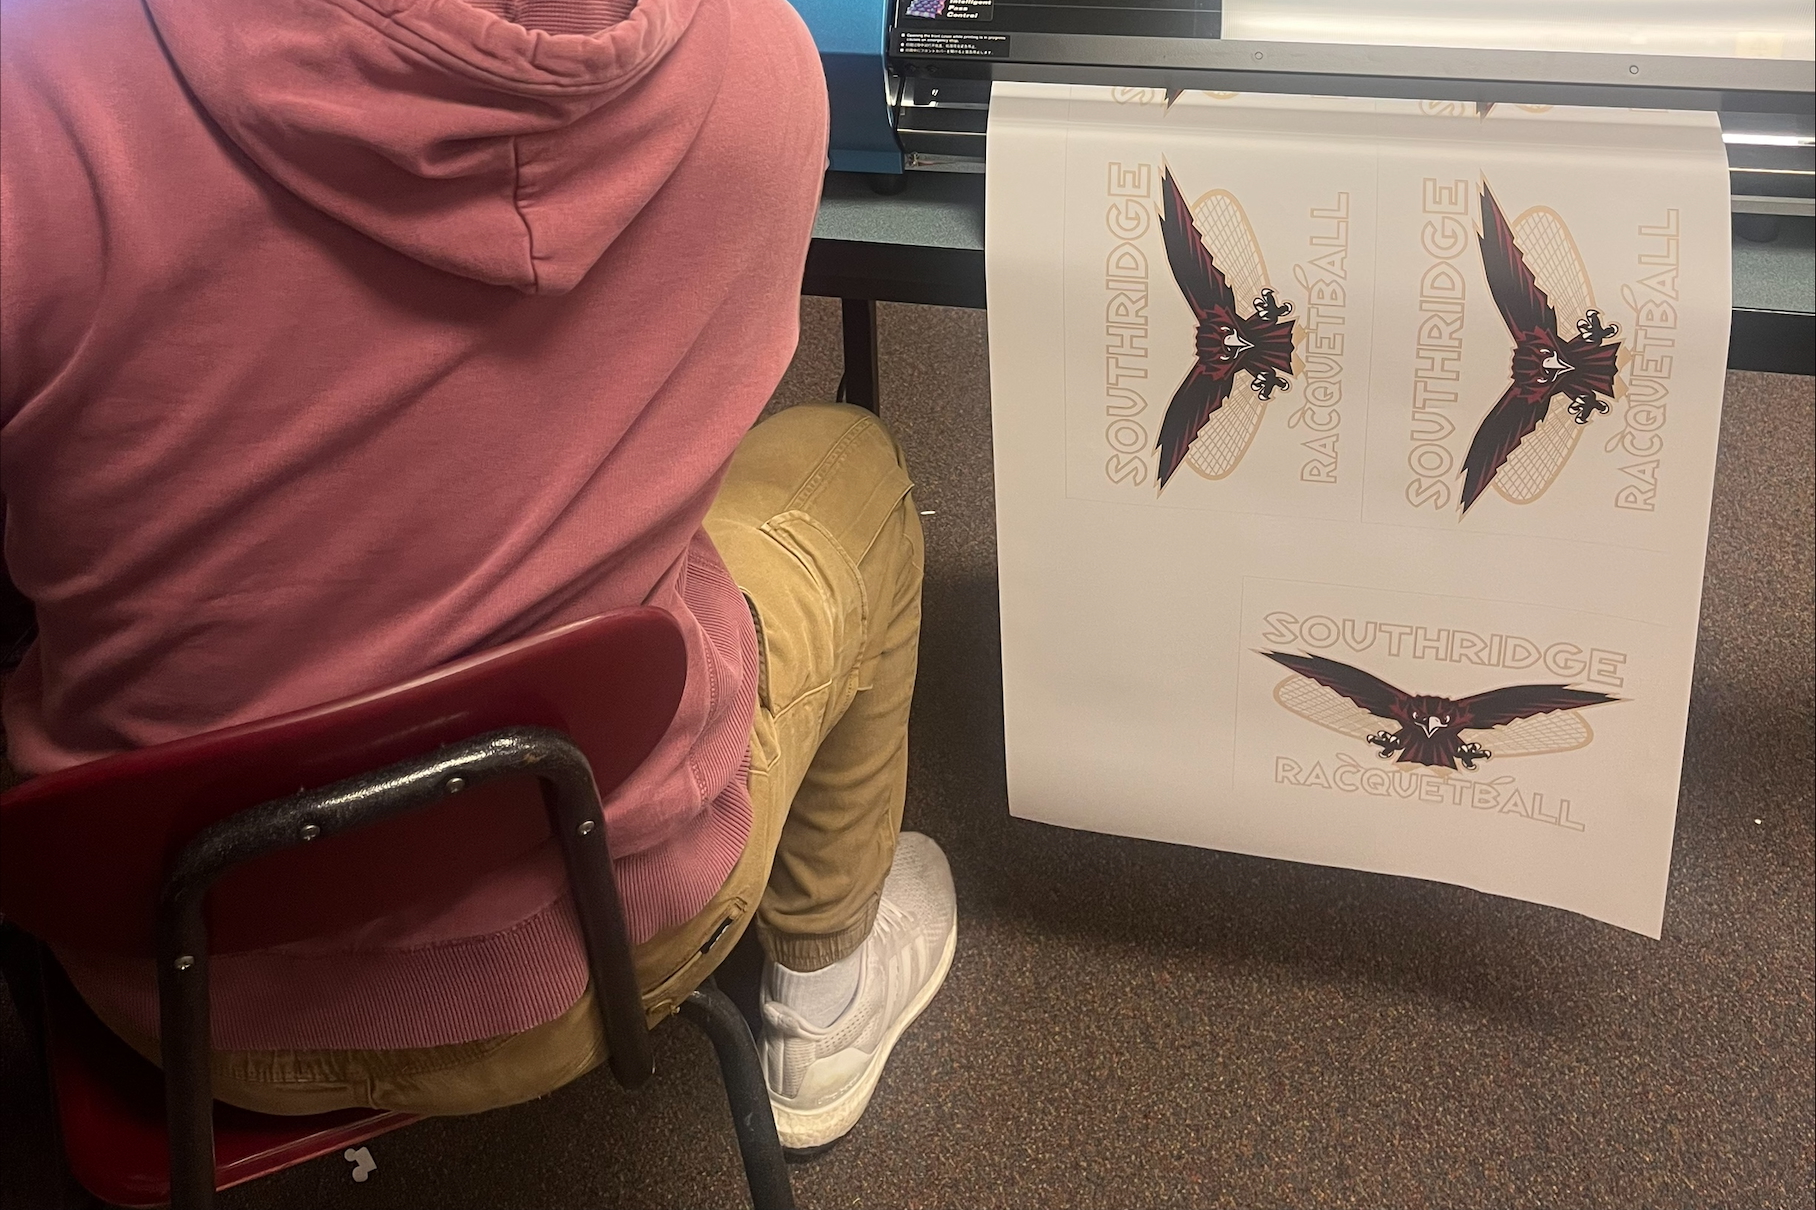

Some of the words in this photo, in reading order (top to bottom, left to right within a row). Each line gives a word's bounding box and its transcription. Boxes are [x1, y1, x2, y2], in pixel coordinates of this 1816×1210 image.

[946, 11, 979, 19] Control
[1105, 161, 1151, 487] SOUTHRIDGE
[1297, 191, 1350, 484] RACQUETBALL
[1405, 177, 1470, 511] SOUTHRIDGE
[1614, 208, 1680, 513] RACQUETBALL
[1261, 611, 1627, 688] SOUTHRIDGE
[1274, 753, 1586, 833] RACQUETBALL
